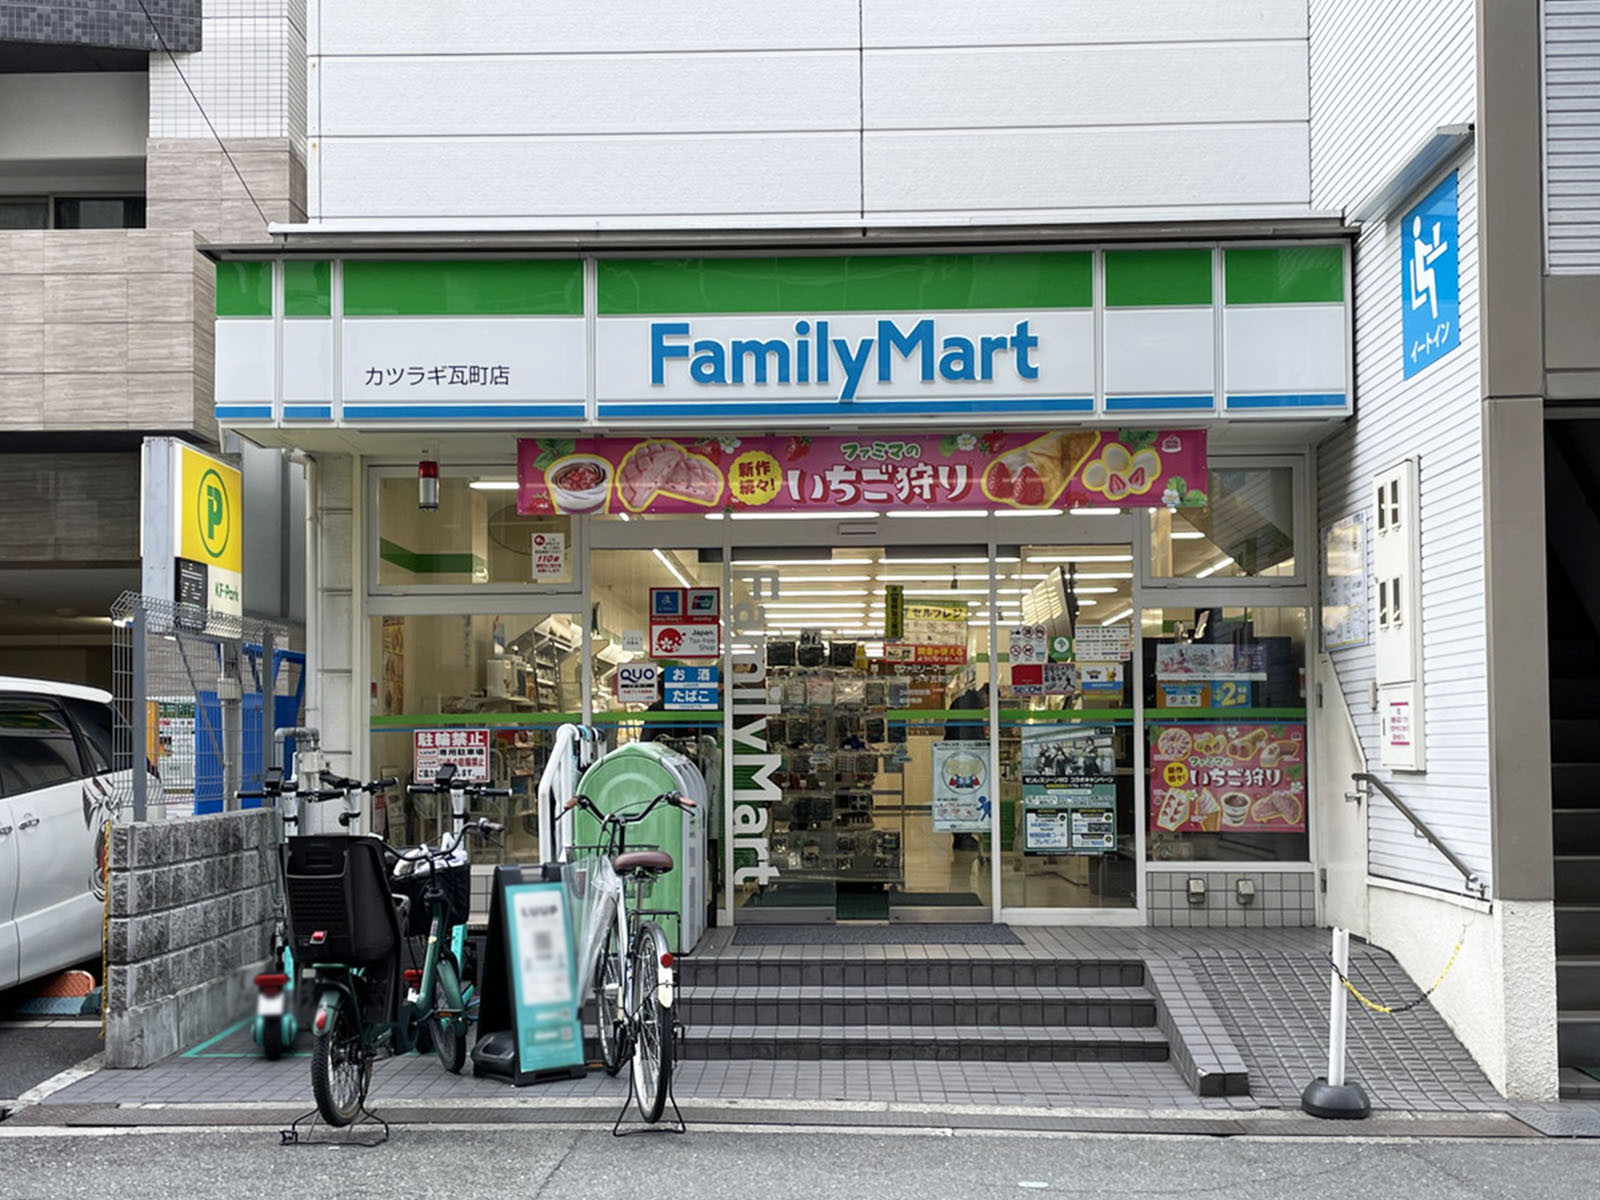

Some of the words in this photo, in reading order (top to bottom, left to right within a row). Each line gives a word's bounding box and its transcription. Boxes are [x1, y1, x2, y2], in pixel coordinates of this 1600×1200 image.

[1410, 321, 1450, 363] イートイン
[651, 319, 1039, 402] FamilyMart
[365, 366, 510, 386] カツラギ瓦町店
[841, 442, 920, 461] ファミマの
[738, 461, 771, 476] 新作
[787, 463, 969, 503] いちご狩り
[620, 668, 655, 683] QUO
[672, 668, 710, 681] お酒
[672, 690, 710, 702] たばこ
[1189, 768, 1281, 787] いちご狩り
